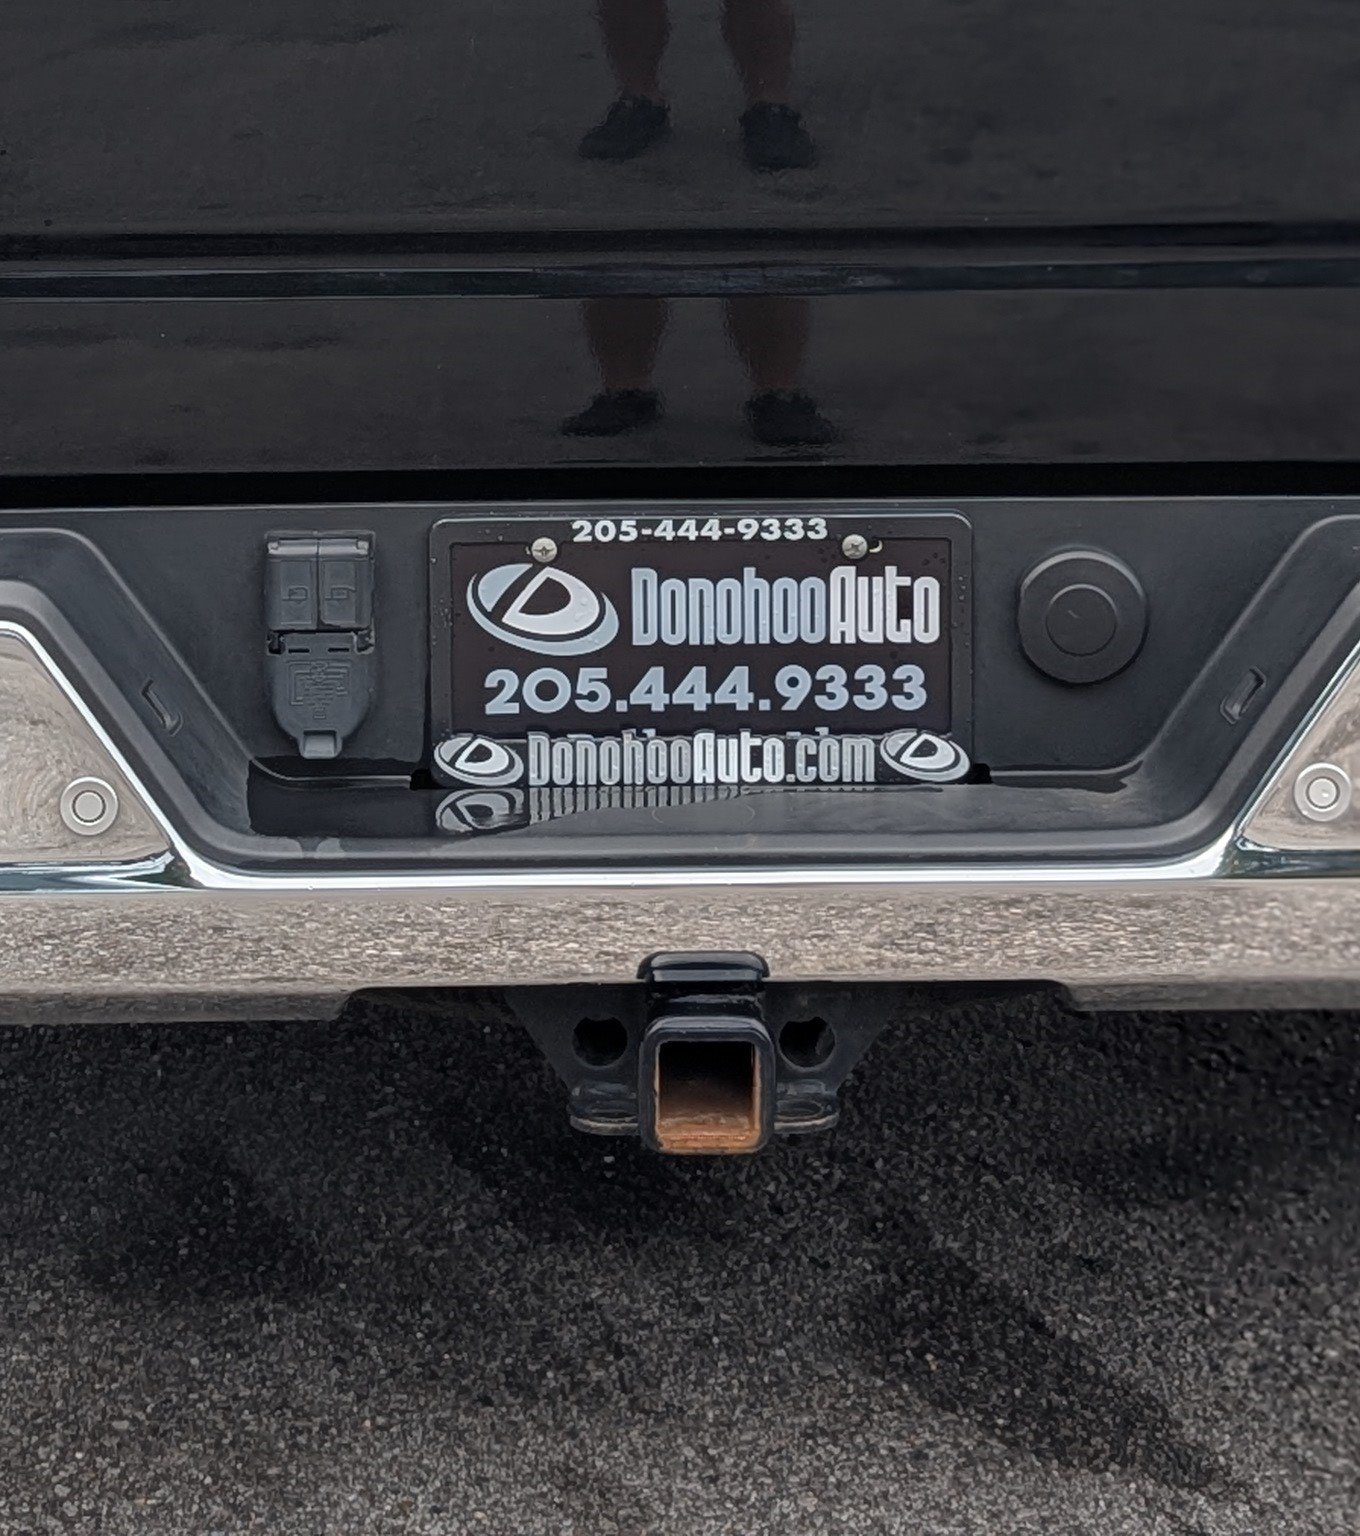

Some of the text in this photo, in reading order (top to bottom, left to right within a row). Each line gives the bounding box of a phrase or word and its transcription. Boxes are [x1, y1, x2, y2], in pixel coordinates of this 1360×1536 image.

[571, 517, 828, 543] 205-444-9333
[631, 566, 940, 646] DonohooAuto
[484, 664, 928, 715] 205.444.9333
[527, 730, 876, 787] DonohooAuto.com
